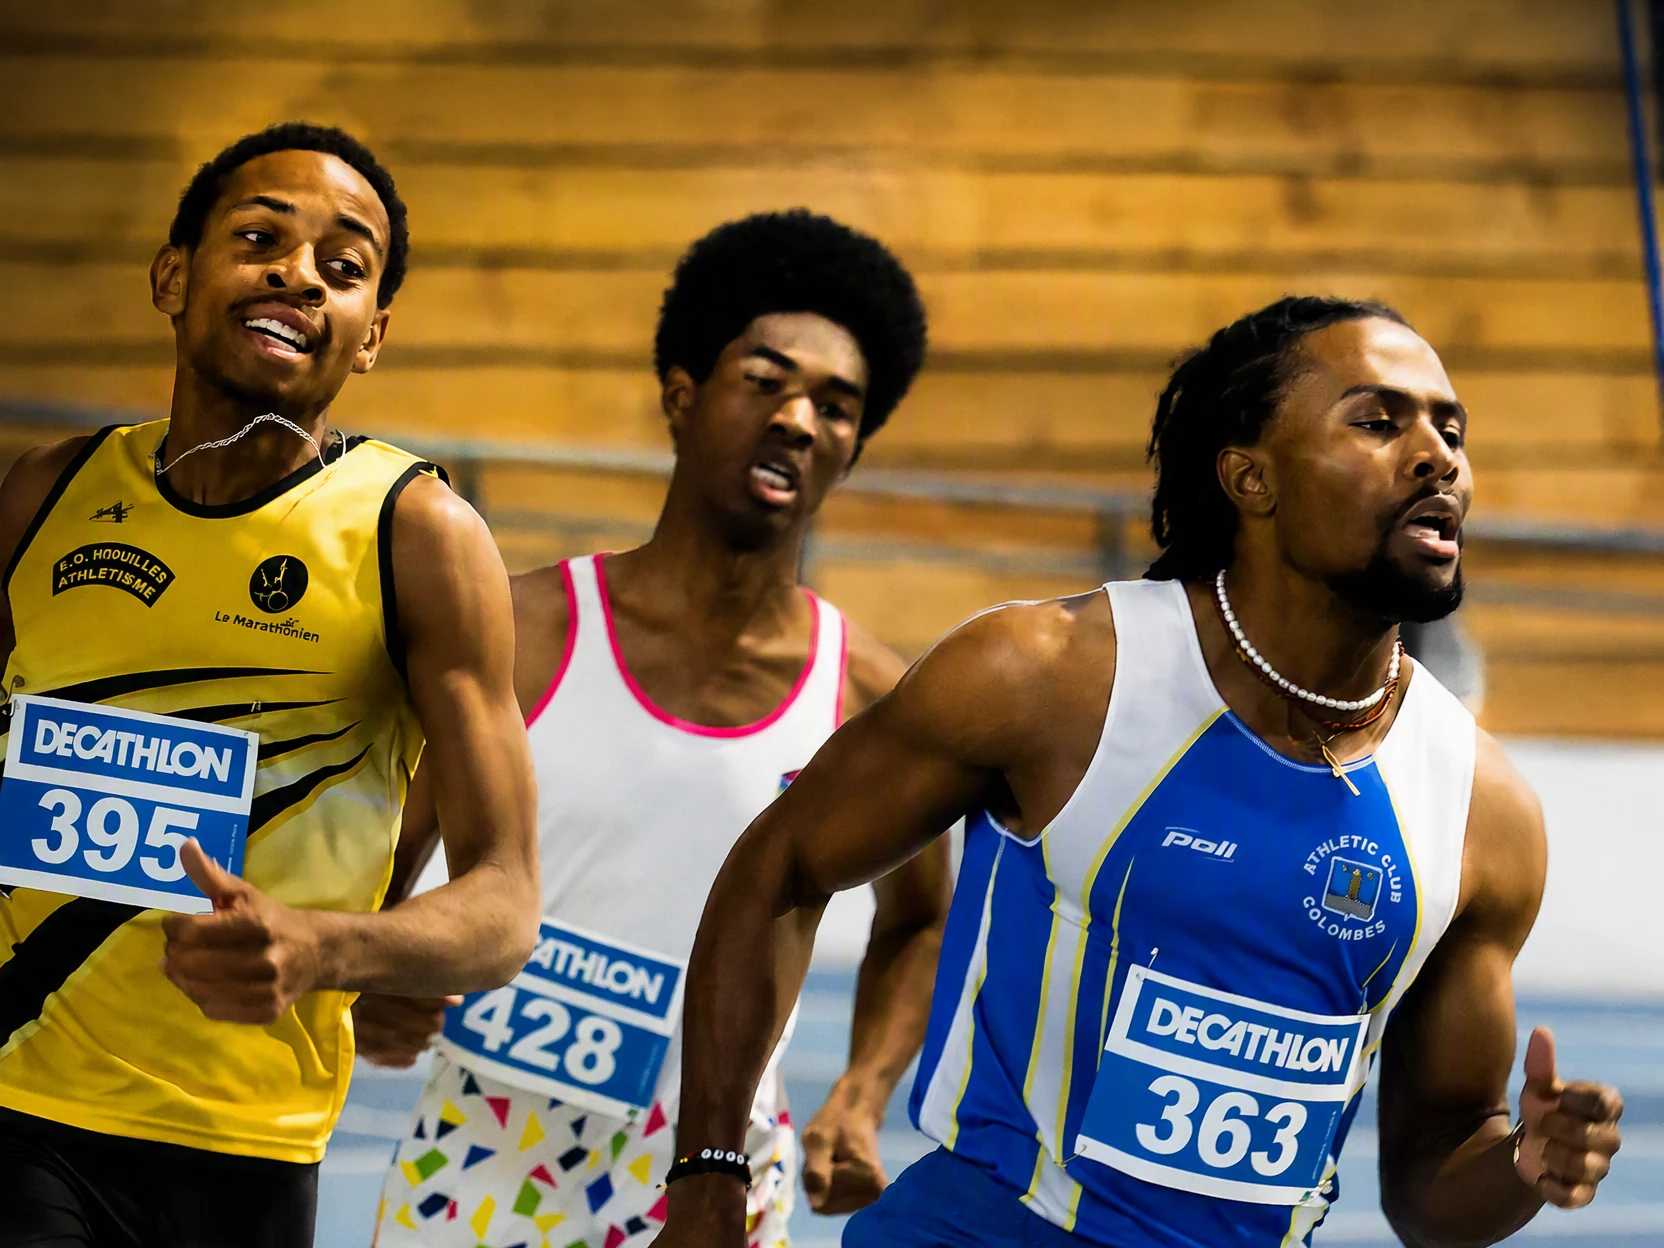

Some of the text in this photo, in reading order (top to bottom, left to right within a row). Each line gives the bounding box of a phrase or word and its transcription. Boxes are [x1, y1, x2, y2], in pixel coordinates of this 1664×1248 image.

[60, 553, 89, 572] E.O.
[214, 610, 320, 643] Le Marathonien
[33, 719, 233, 783] DECATHLON
[31, 788, 200, 882] 395
[1303, 835, 1402, 903] ATHLETIC CLUB
[1303, 896, 1386, 941] COLOMBES
[528, 933, 665, 1005] ATHLON
[461, 985, 623, 1085] 428
[1146, 997, 1349, 1072] DECATHLON
[1135, 1075, 1308, 1177] 363
